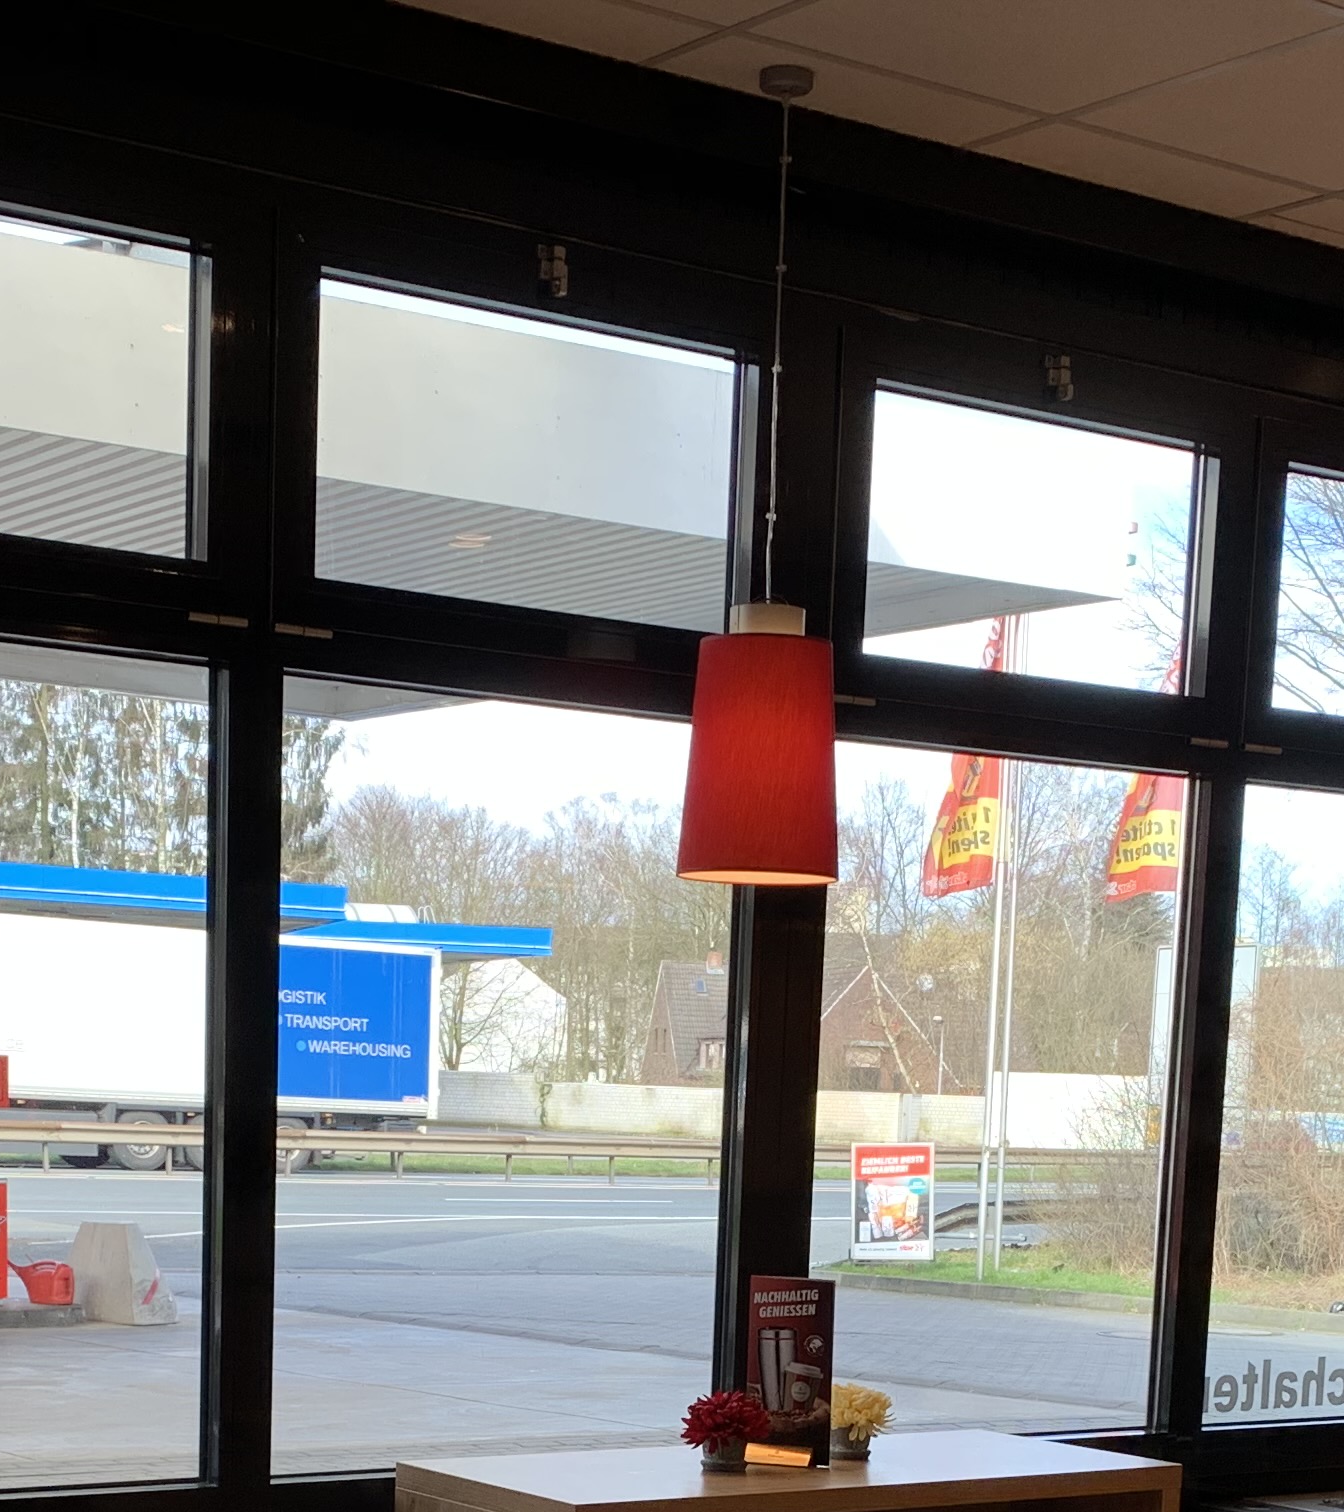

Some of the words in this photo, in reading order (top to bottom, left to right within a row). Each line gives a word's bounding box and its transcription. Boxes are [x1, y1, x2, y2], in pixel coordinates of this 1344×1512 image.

[279, 989, 327, 1005] GISTIK
[284, 1013, 369, 1032] TRANSPORT
[308, 1039, 411, 1058] WAREHOUSING
[754, 1289, 819, 1304] NACHHALTIG
[759, 1303, 817, 1318] GENIESSEN
